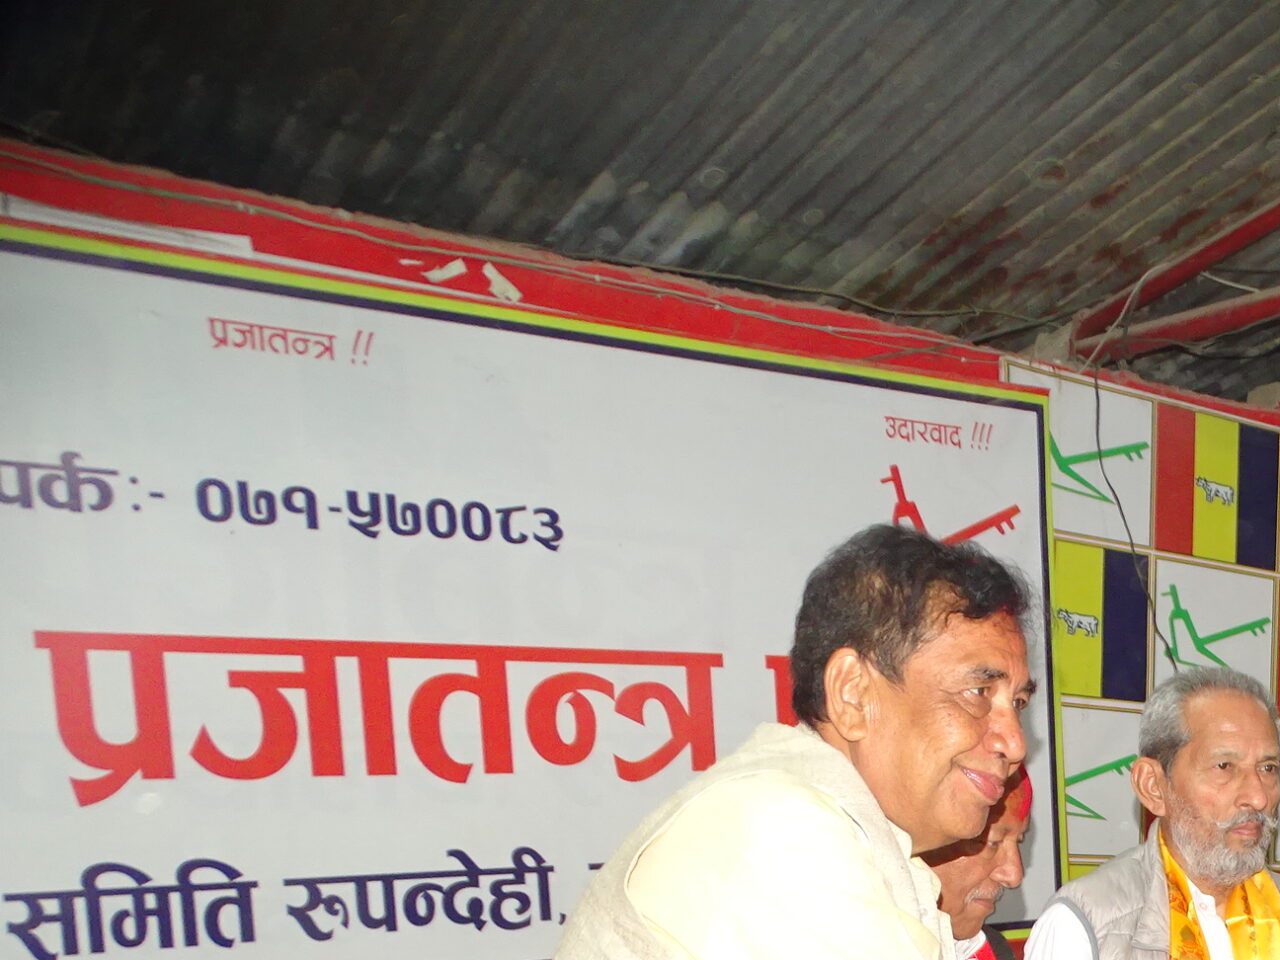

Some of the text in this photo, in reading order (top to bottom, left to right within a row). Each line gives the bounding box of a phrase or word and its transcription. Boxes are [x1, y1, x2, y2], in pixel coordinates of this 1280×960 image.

[207, 317, 337, 362] प्रजातन्त्र
[885, 415, 962, 450] उदारवाद
[33, 630, 724, 807] प्रजातन्त्र
